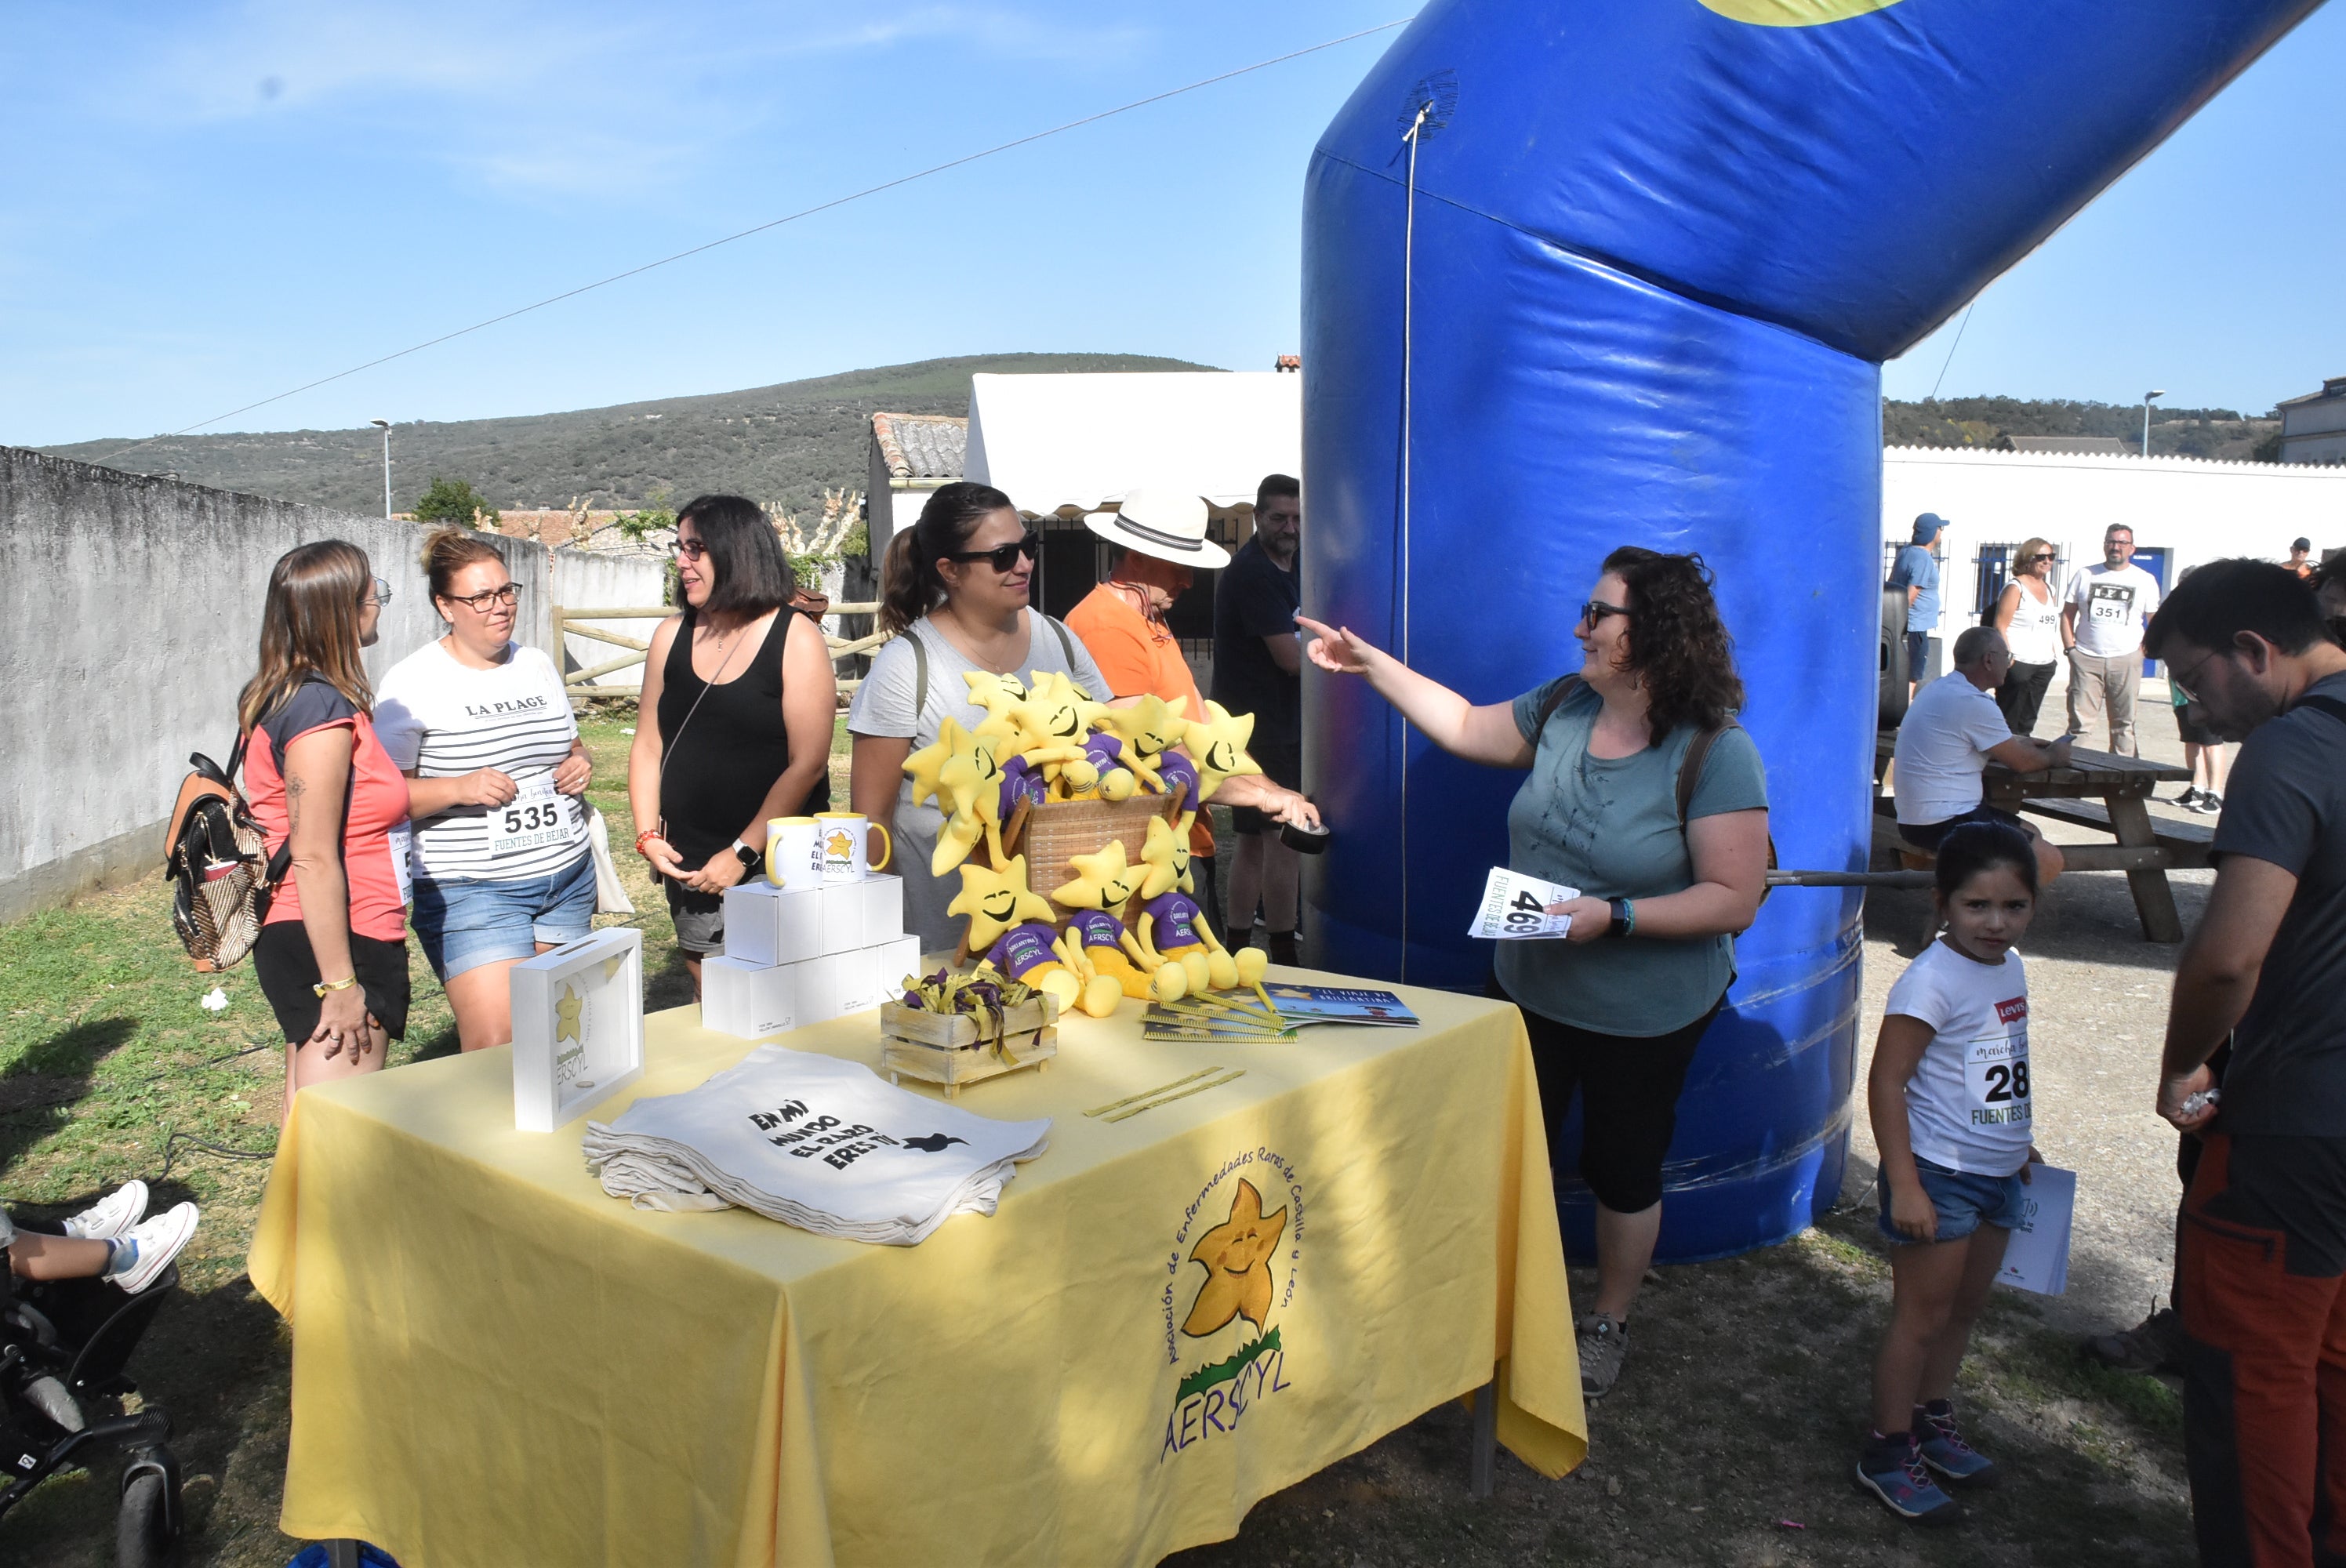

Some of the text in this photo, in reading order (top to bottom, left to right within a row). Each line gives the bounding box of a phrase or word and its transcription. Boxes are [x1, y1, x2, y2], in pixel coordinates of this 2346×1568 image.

[2095, 607, 2121, 619] 351
[465, 695, 547, 717] LA PLAGE
[505, 803, 557, 833] 535
[495, 828, 570, 851] FUENTES DE BÉJAR
[1487, 875, 1509, 914] FUENTES
[1485, 913, 1501, 923] DE
[1503, 891, 1545, 934] 469
[1089, 933, 1116, 942] AERSCYL
[1015, 949, 1043, 967] AERSCYL
[557, 1053, 588, 1086] ERSCYL
[1985, 1061, 2029, 1103] 28
[748, 1112, 783, 1131] EN
[1971, 1106, 2022, 1125] FUENTES
[767, 1116, 841, 1146] MUNDO
[789, 1124, 875, 1158] EL RARO
[822, 1141, 879, 1171] ERES
[1258, 1146, 1285, 1169] Raras
[1283, 1165, 1295, 1183] de
[1177, 1151, 1254, 1244] Enfermedades
[1291, 1185, 1306, 1243] Castilla
[1167, 1252, 1180, 1275] de
[1291, 1250, 1299, 1259] y
[1280, 1268, 1298, 1308] León
[1160, 1351, 1291, 1465] AERSCYL
